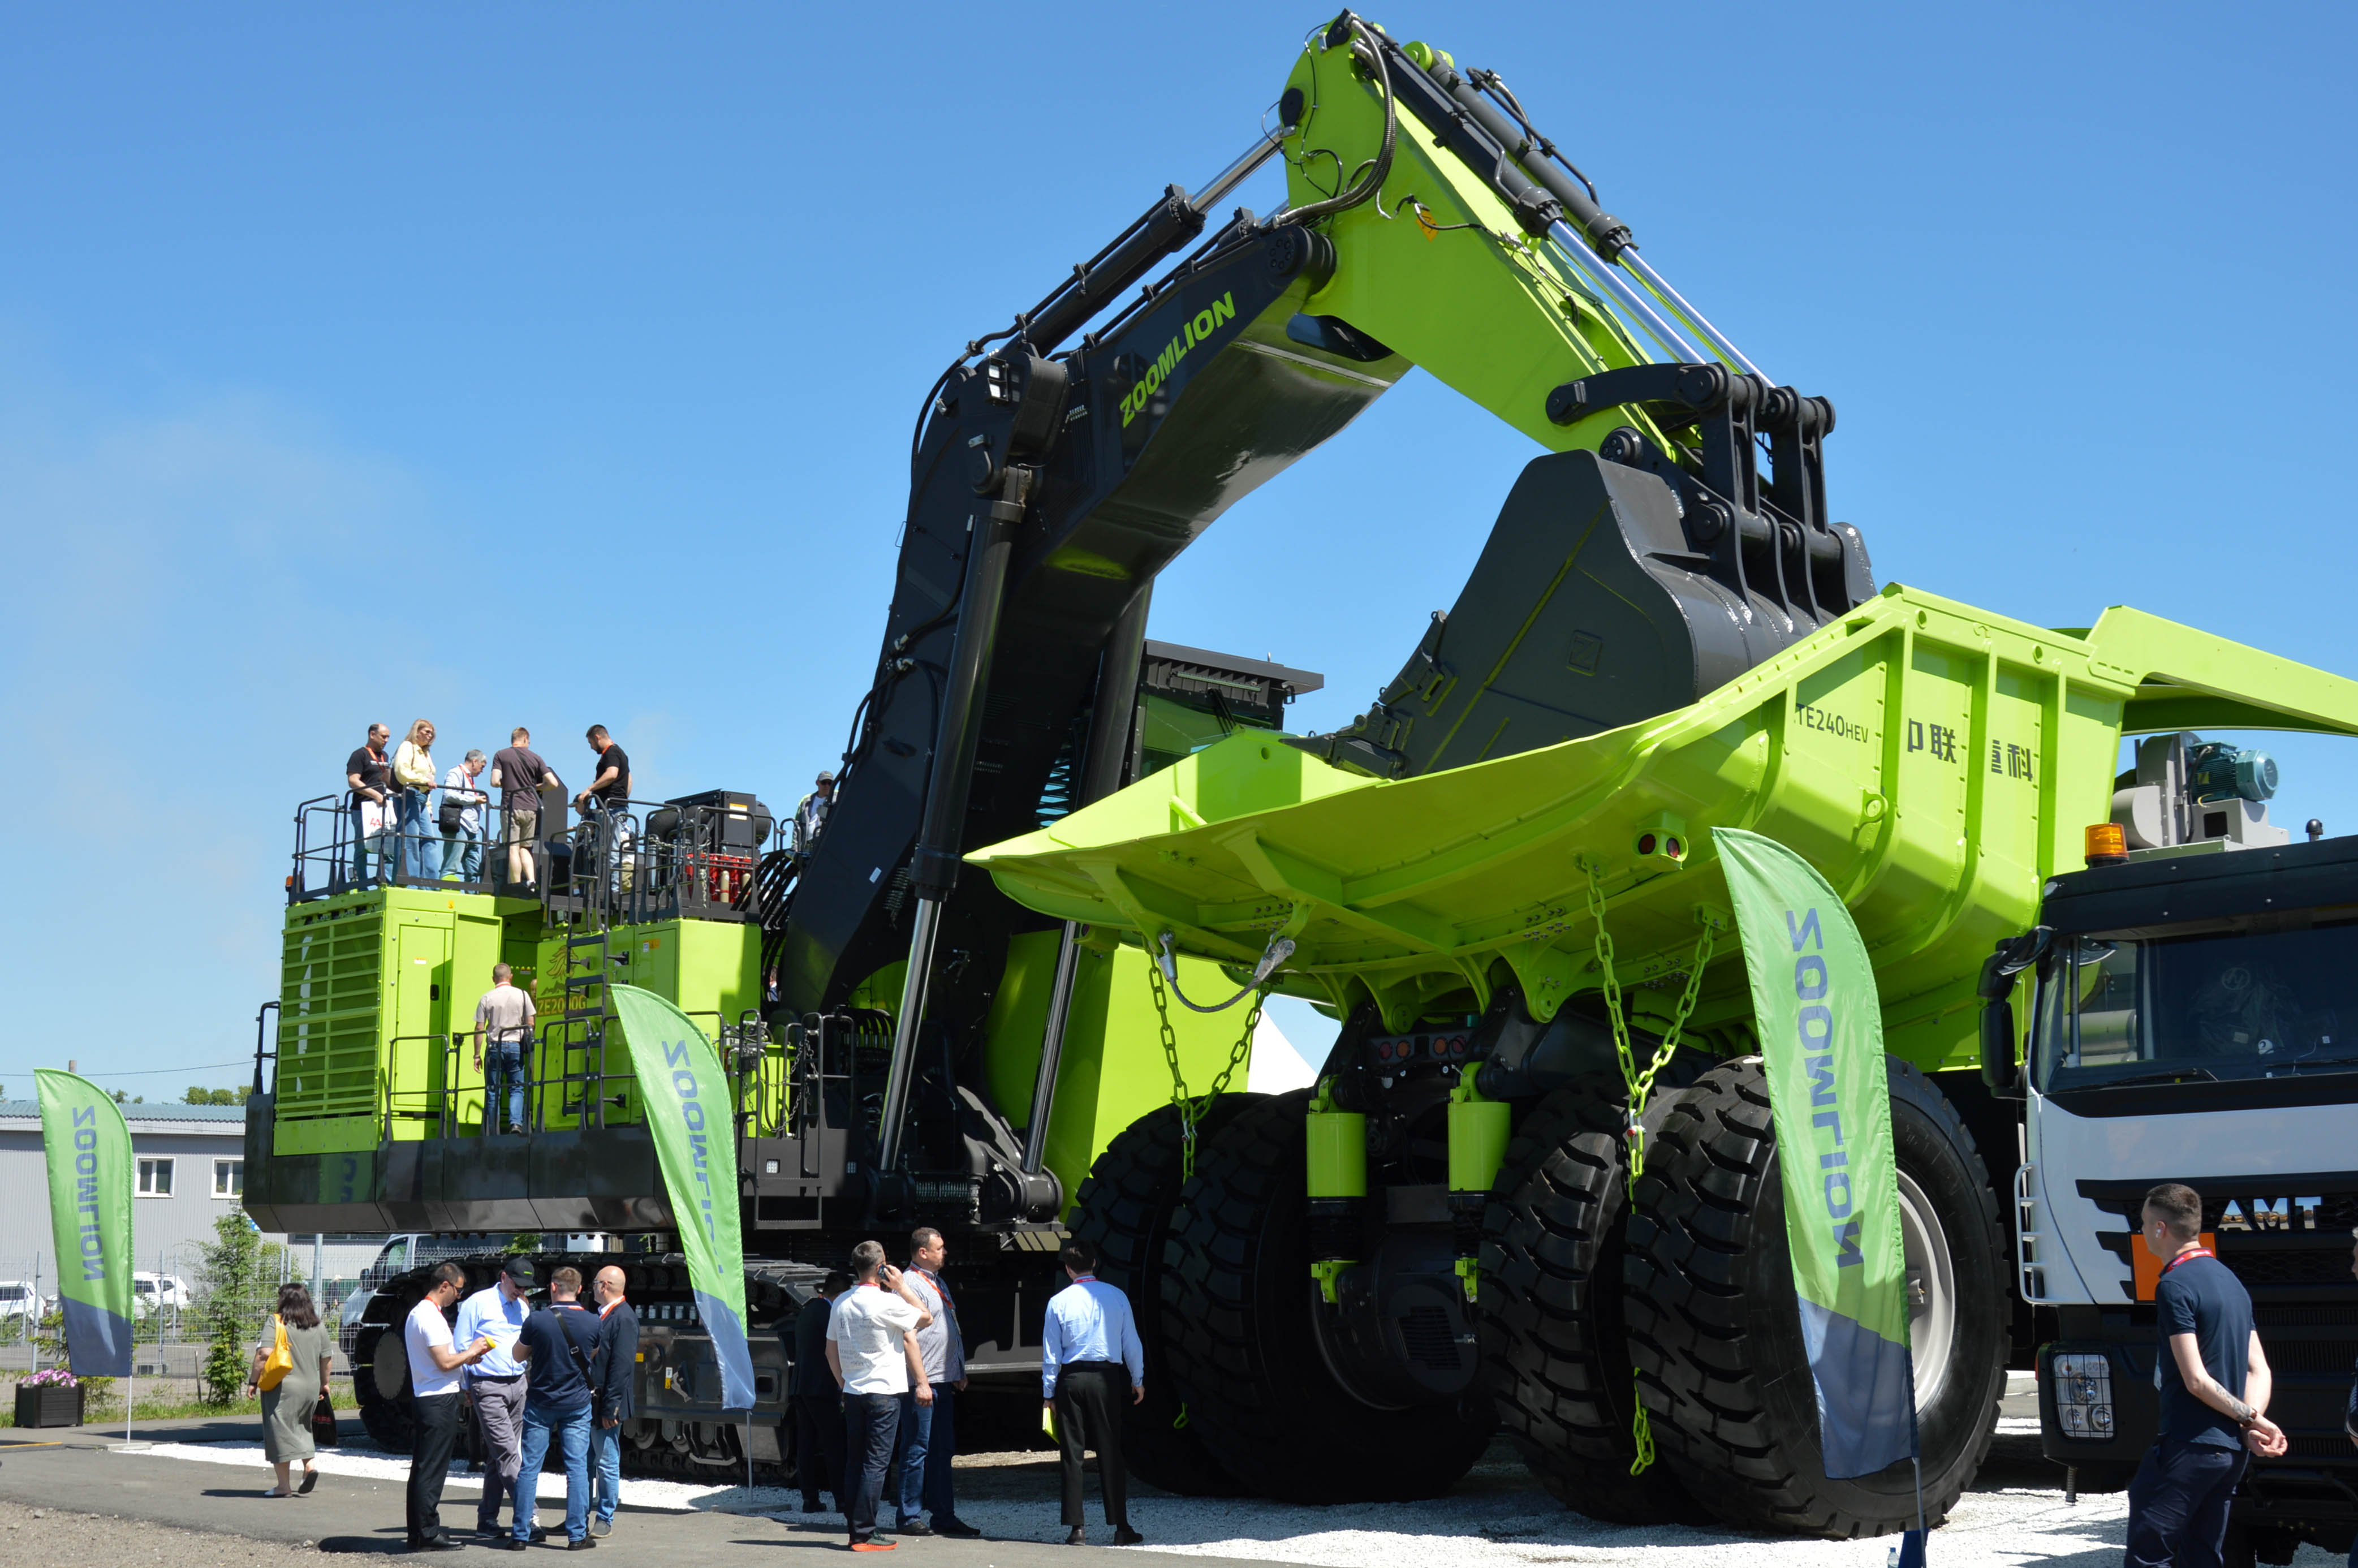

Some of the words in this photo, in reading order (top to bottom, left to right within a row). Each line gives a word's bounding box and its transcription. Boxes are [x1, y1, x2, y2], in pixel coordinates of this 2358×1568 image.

[1120, 291, 1236, 428] ZOOMLION
[1794, 703, 1868, 743] TE240HEV
[2218, 1196, 2323, 1231] AMT
